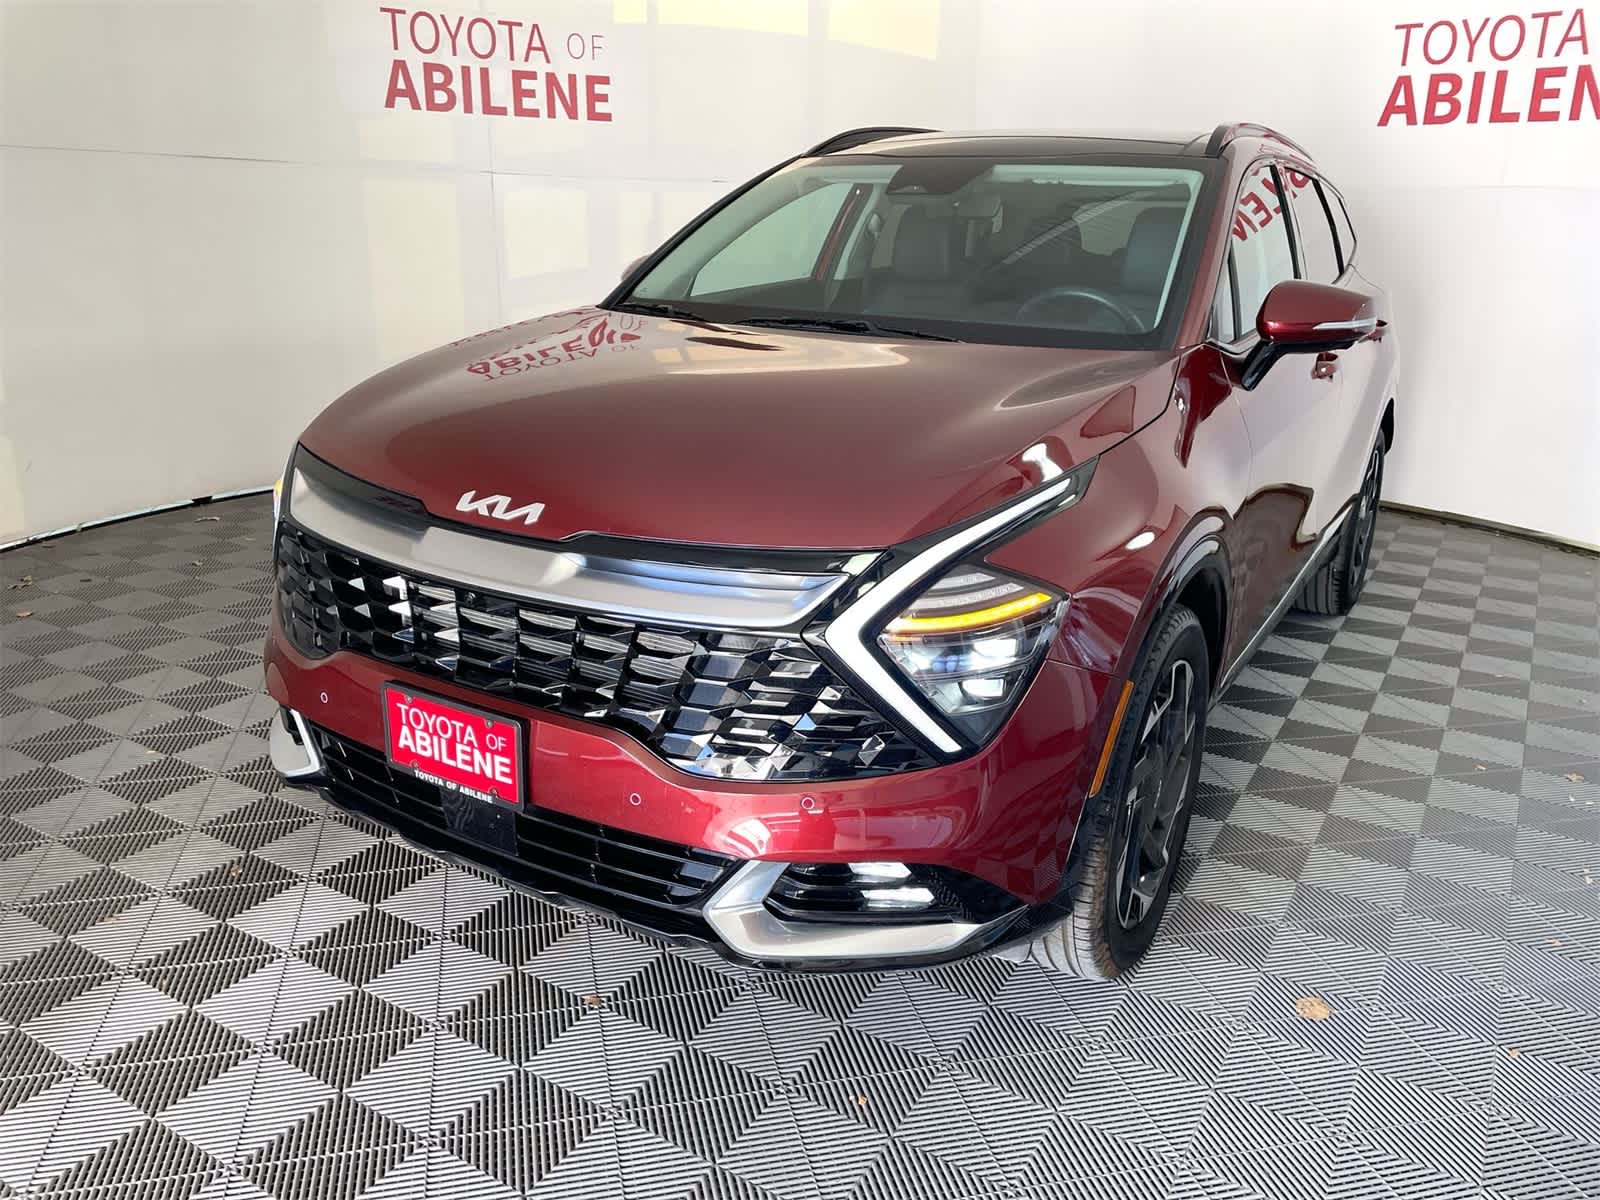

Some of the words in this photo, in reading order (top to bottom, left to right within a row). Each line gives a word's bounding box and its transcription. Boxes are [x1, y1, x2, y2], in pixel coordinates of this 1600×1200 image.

[380, 7, 551, 64] TOYOTA
[566, 33, 605, 61] OF
[1395, 8, 1589, 66] TOYOTA
[384, 59, 612, 122] ABILENE
[456, 490, 545, 525] KIA
[396, 703, 478, 747] TOYOTA
[485, 733, 507, 751] OF
[398, 725, 513, 785] ABILENE
[414, 769, 444, 786] TOYOTA
[446, 781, 458, 791] OF
[459, 785, 494, 803] ABILENE
